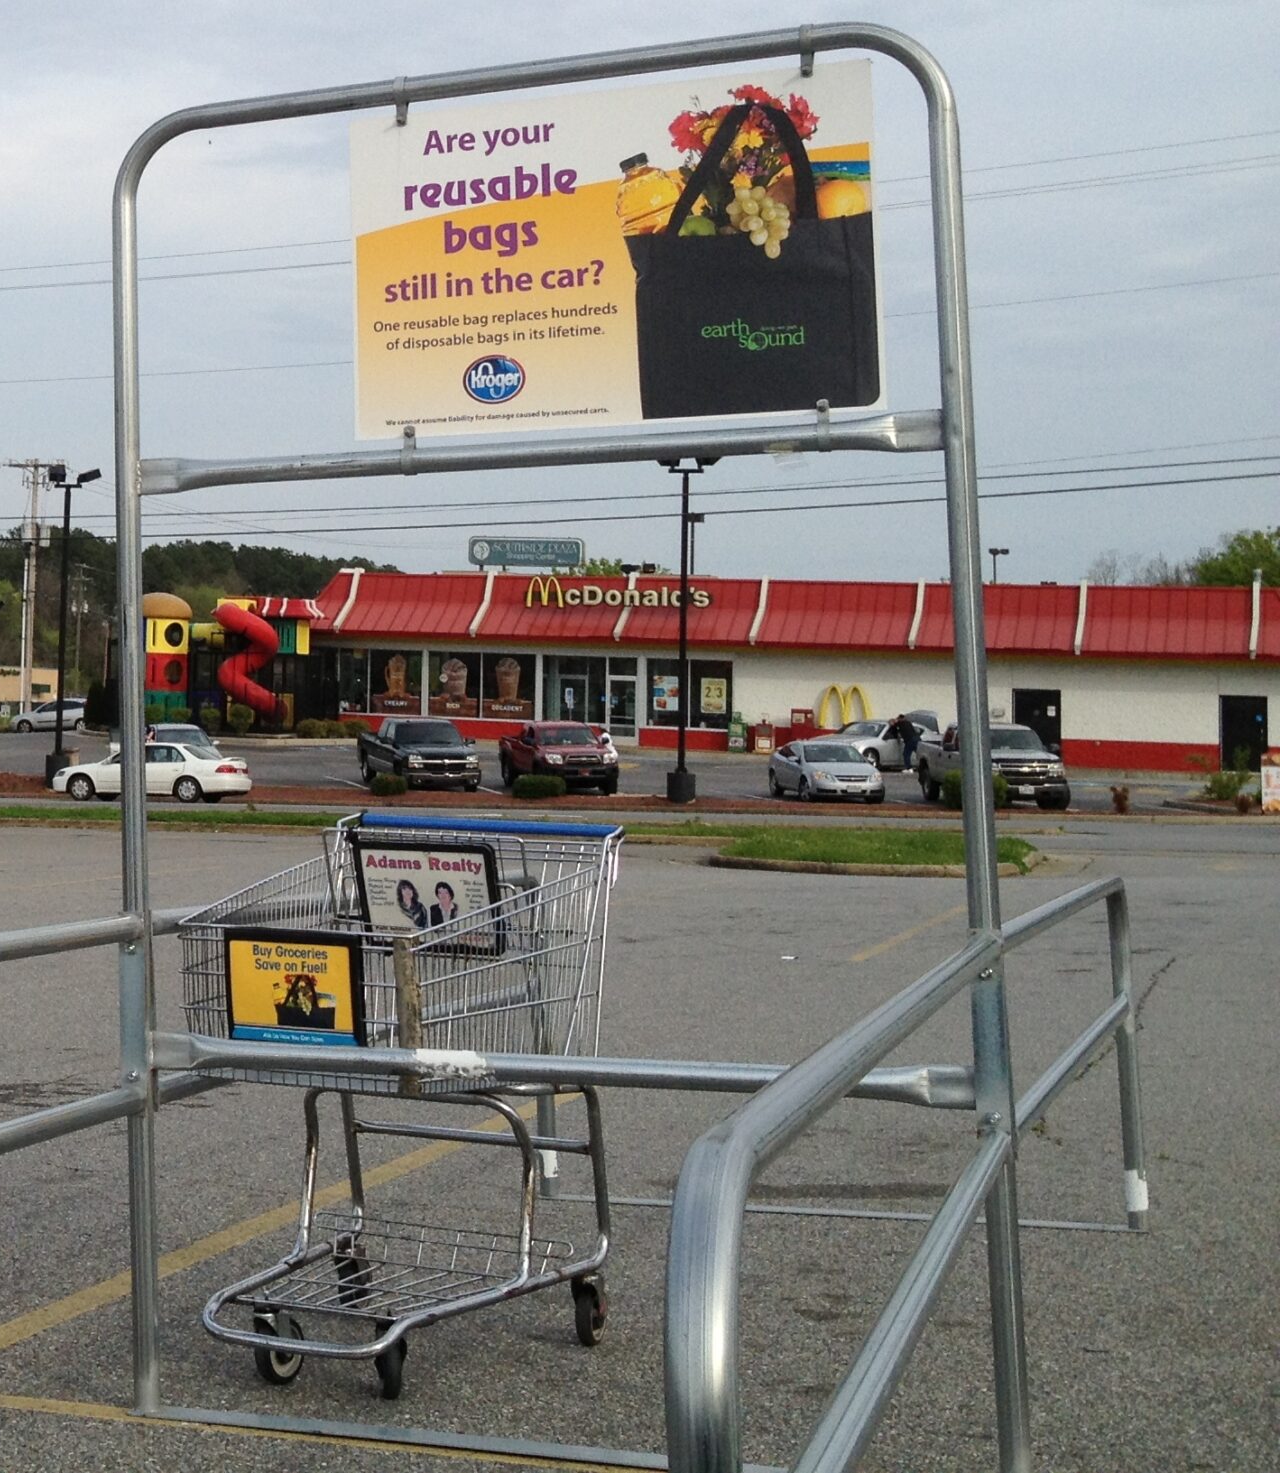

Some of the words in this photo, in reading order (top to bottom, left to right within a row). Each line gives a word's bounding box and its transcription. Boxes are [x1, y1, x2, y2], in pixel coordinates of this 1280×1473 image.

[423, 130, 475, 155] Are
[483, 122, 554, 156] your
[404, 163, 577, 211] reusable
[444, 220, 538, 257] bags
[385, 273, 437, 302] still
[446, 272, 473, 298] in
[482, 268, 532, 294] the
[541, 259, 604, 289] car?
[373, 321, 400, 333] One
[403, 315, 459, 331] reusable
[463, 313, 488, 327] bag
[492, 310, 548, 325] replaces
[551, 303, 618, 319] hundreds
[701, 318, 750, 338] earth
[386, 339, 400, 350] of
[403, 333, 474, 350] disposable
[477, 331, 509, 346] bags
[513, 330, 525, 341] in
[529, 328, 545, 340] its
[548, 324, 605, 339] lifetime.
[470, 362, 520, 398] Kroger
[541, 410, 550, 418] by
[551, 408, 588, 416] unsecured
[492, 541, 545, 553] SOUTHSIDE
[548, 542, 577, 553] PLAZA
[491, 704, 523, 712] DECADENT
[366, 854, 422, 870] Adams
[428, 856, 482, 875] Realty
[252, 944, 272, 958] Buy
[275, 946, 328, 959] Groceries
[255, 958, 280, 972] Save
[284, 962, 297, 972] on
[301, 961, 327, 974] Fuel!
